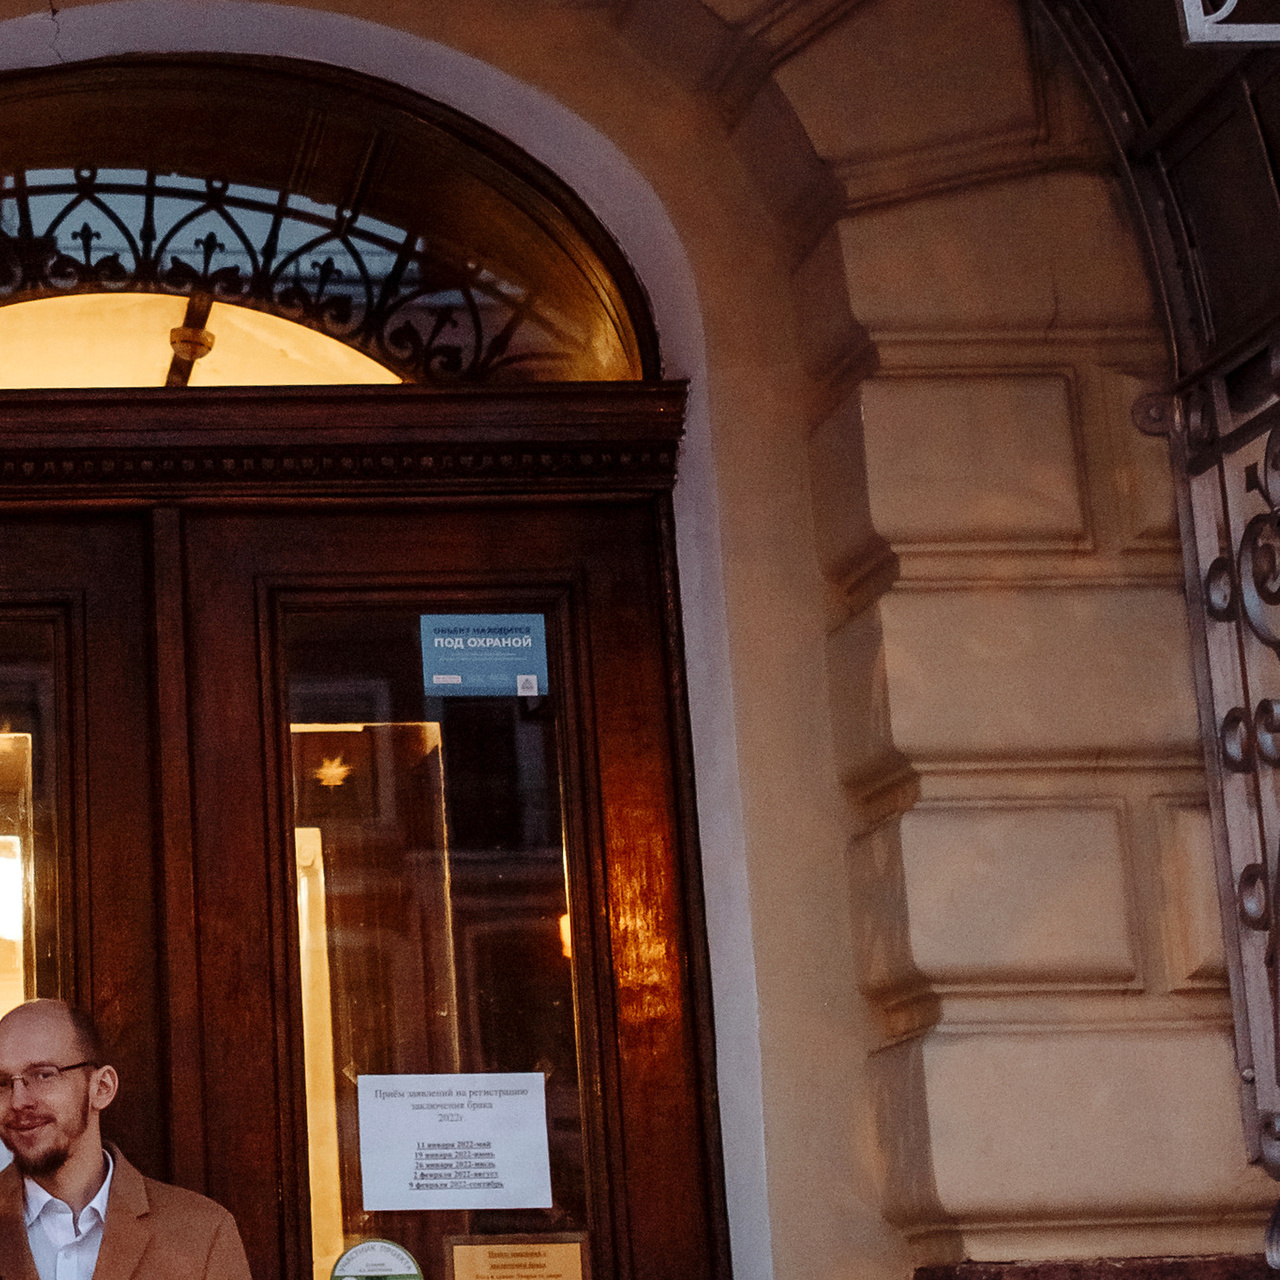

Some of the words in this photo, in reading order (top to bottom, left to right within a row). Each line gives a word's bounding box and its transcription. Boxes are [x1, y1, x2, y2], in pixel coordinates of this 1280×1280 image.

[434, 637, 464, 649] ПОД
[467, 635, 532, 647] ОХРАНОЙ
[374, 1089, 405, 1100] Приём
[408, 1088, 453, 1098] заявлений
[468, 1088, 528, 1099] регистрацию
[411, 1102, 464, 1110] заключения
[467, 1101, 493, 1111] брака
